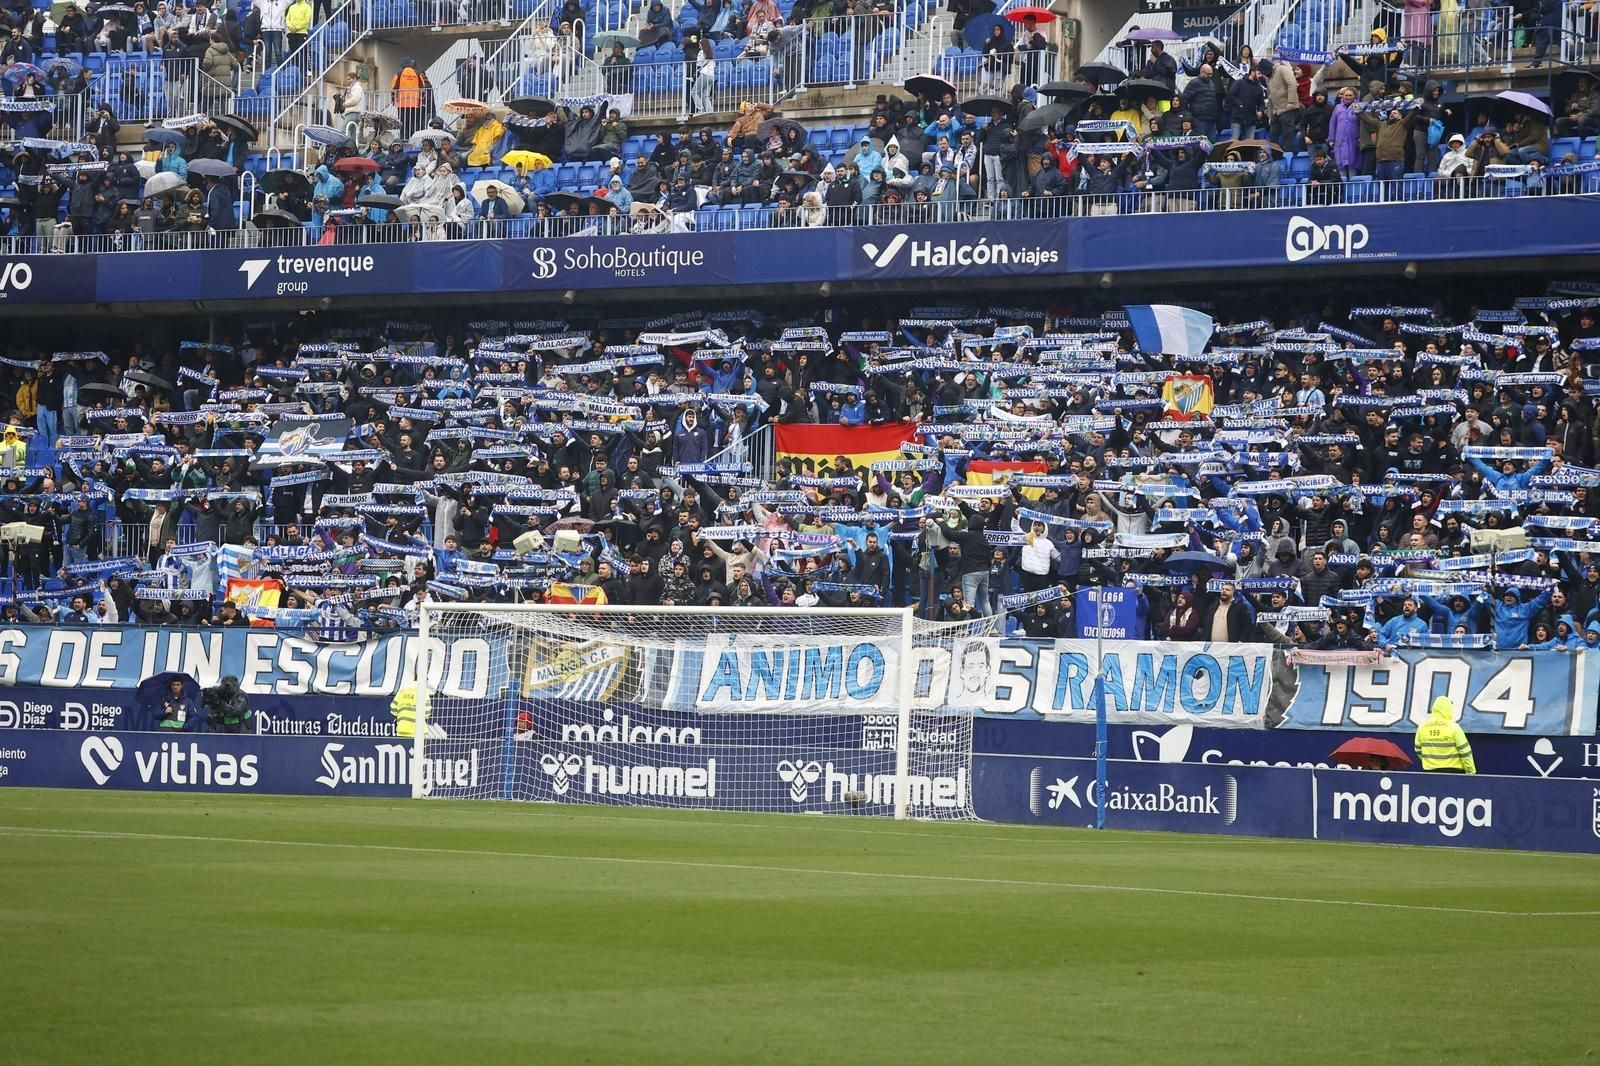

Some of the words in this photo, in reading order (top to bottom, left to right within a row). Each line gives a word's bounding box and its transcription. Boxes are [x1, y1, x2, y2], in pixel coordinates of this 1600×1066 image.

[1184, 16, 1220, 27] SALIDA
[1301, 53, 1325, 62] MALAGA
[911, 238, 1008, 266] Halcón
[1011, 246, 1058, 266] viajes
[278, 254, 374, 277] trevenque
[615, 269, 645, 277] HOTELS
[277, 281, 308, 294] group
[1550, 300, 1581, 308] ONDO
[1463, 331, 1490, 342] ONDO
[1421, 353, 1449, 363] ONDO
[1460, 370, 1481, 378] NDO
[810, 383, 835, 391] ONDO
[547, 392, 576, 400] ONDO
[1342, 396, 1378, 405] FONDO
[589, 404, 617, 413] MALAGA
[1213, 407, 1240, 416] ONDO
[1391, 408, 1419, 416] ONDO
[1224, 419, 1251, 427] ONDO
[1175, 452, 1215, 462] MALAGA
[873, 462, 905, 470] FONDO
[1296, 478, 1330, 487] NCIBLES
[1535, 476, 1579, 484] FONDO
[1361, 486, 1381, 494] NDO
[984, 534, 1010, 542] ERRERO
[304, 552, 333, 562] ONDO
[1331, 554, 1356, 563] NDO
[1088, 591, 1124, 603] MLAGA
[40, 631, 122, 688] DE
[138, 632, 223, 688] UN
[701, 635, 885, 702] ÁNIMO
[1052, 642, 1266, 715] RAMÓN
[1322, 657, 1535, 728] 1904
[23, 701, 53, 715] Diego
[92, 703, 122, 715] Diego
[23, 714, 45, 724] Díaz
[92, 715, 114, 726] Díaz
[255, 710, 321, 735] Pinturas
[327, 712, 397, 736] Andalucí
[135, 743, 258, 786] vithas
[585, 755, 715, 797] hummel
[825, 762, 967, 808] hummel
[1087, 779, 1220, 814] CaixaBank
[1333, 776, 1493, 837] málaga
